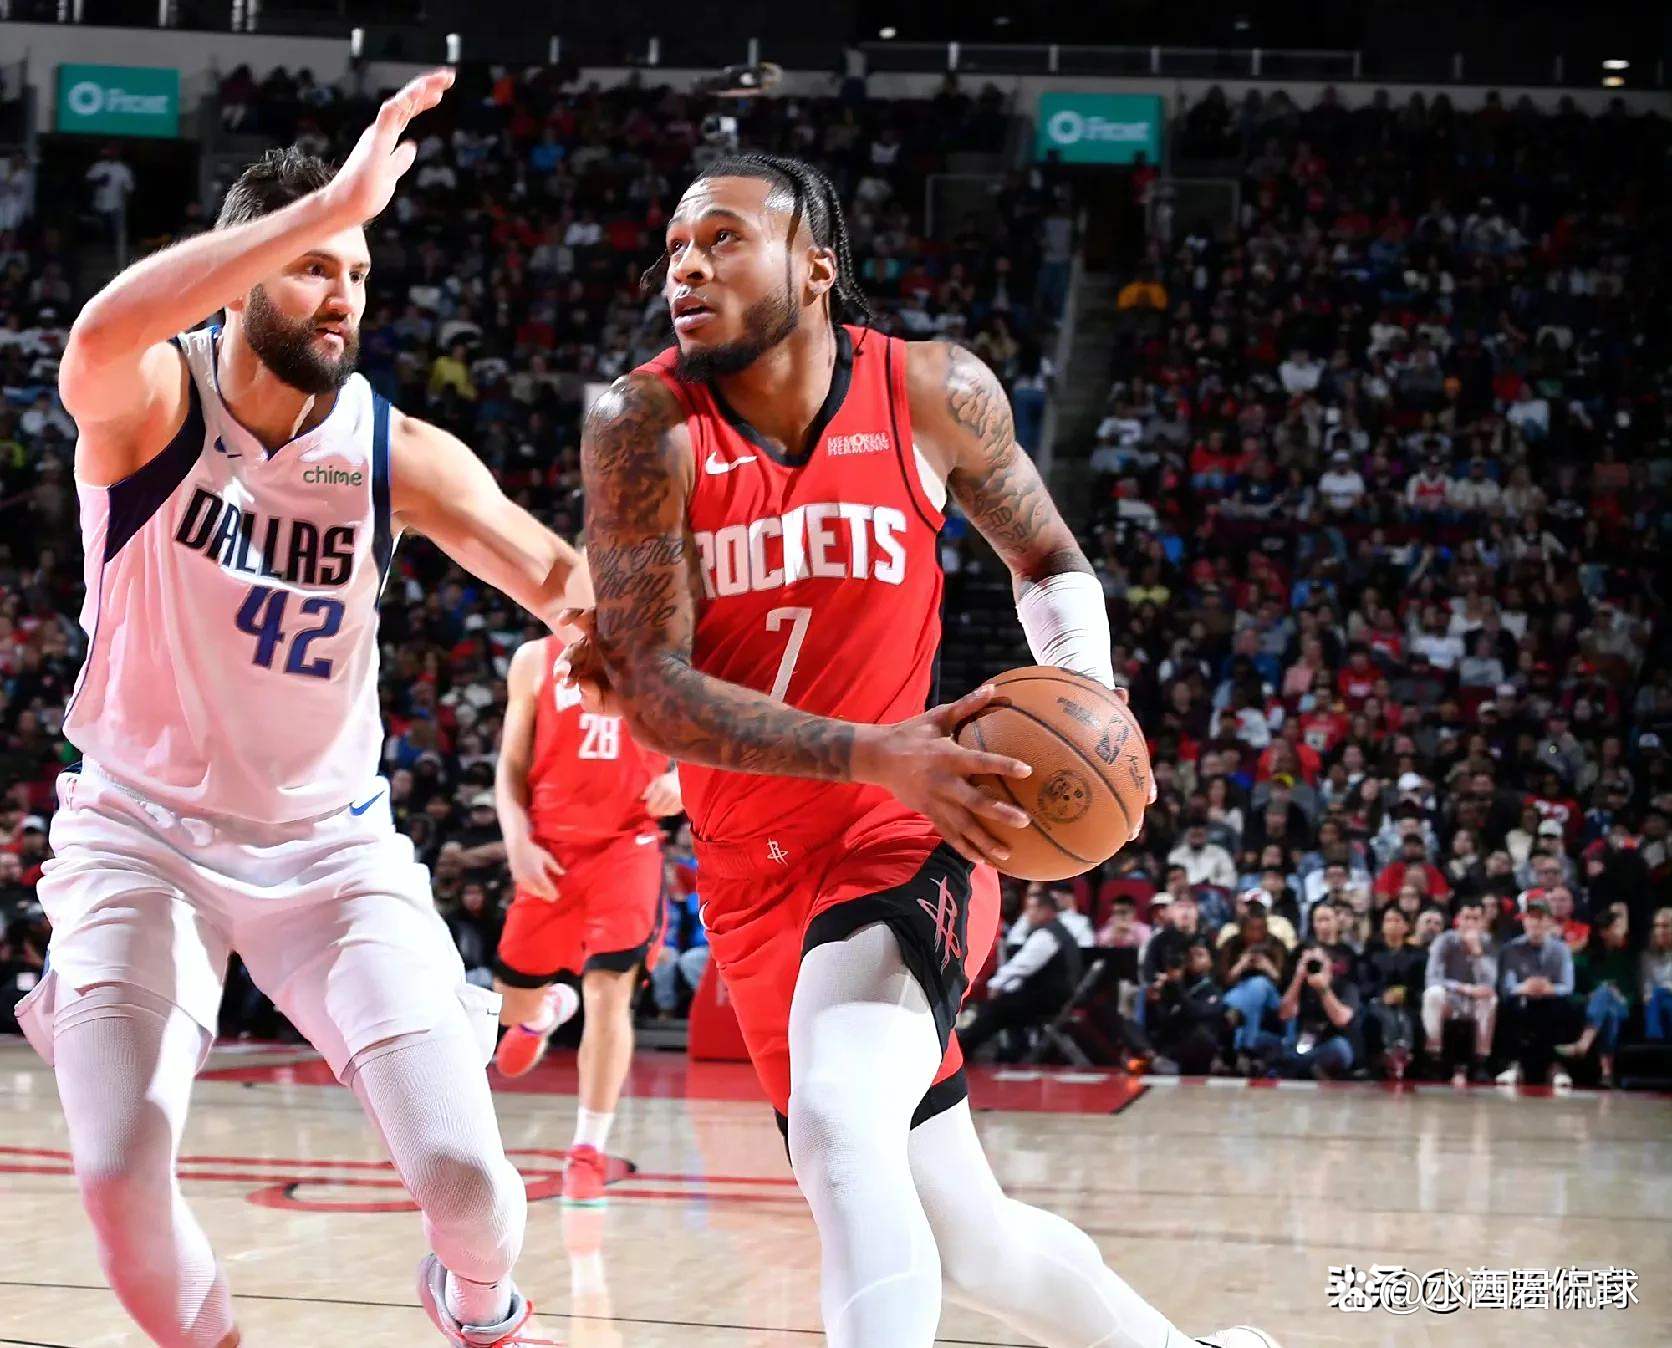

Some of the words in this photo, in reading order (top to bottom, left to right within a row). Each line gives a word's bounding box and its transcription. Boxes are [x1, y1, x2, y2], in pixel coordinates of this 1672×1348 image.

[302, 465, 363, 486] chime
[174, 487, 356, 586] DALLAS
[235, 585, 346, 679] 42
[765, 606, 812, 703] 7
[578, 712, 620, 760] 28
